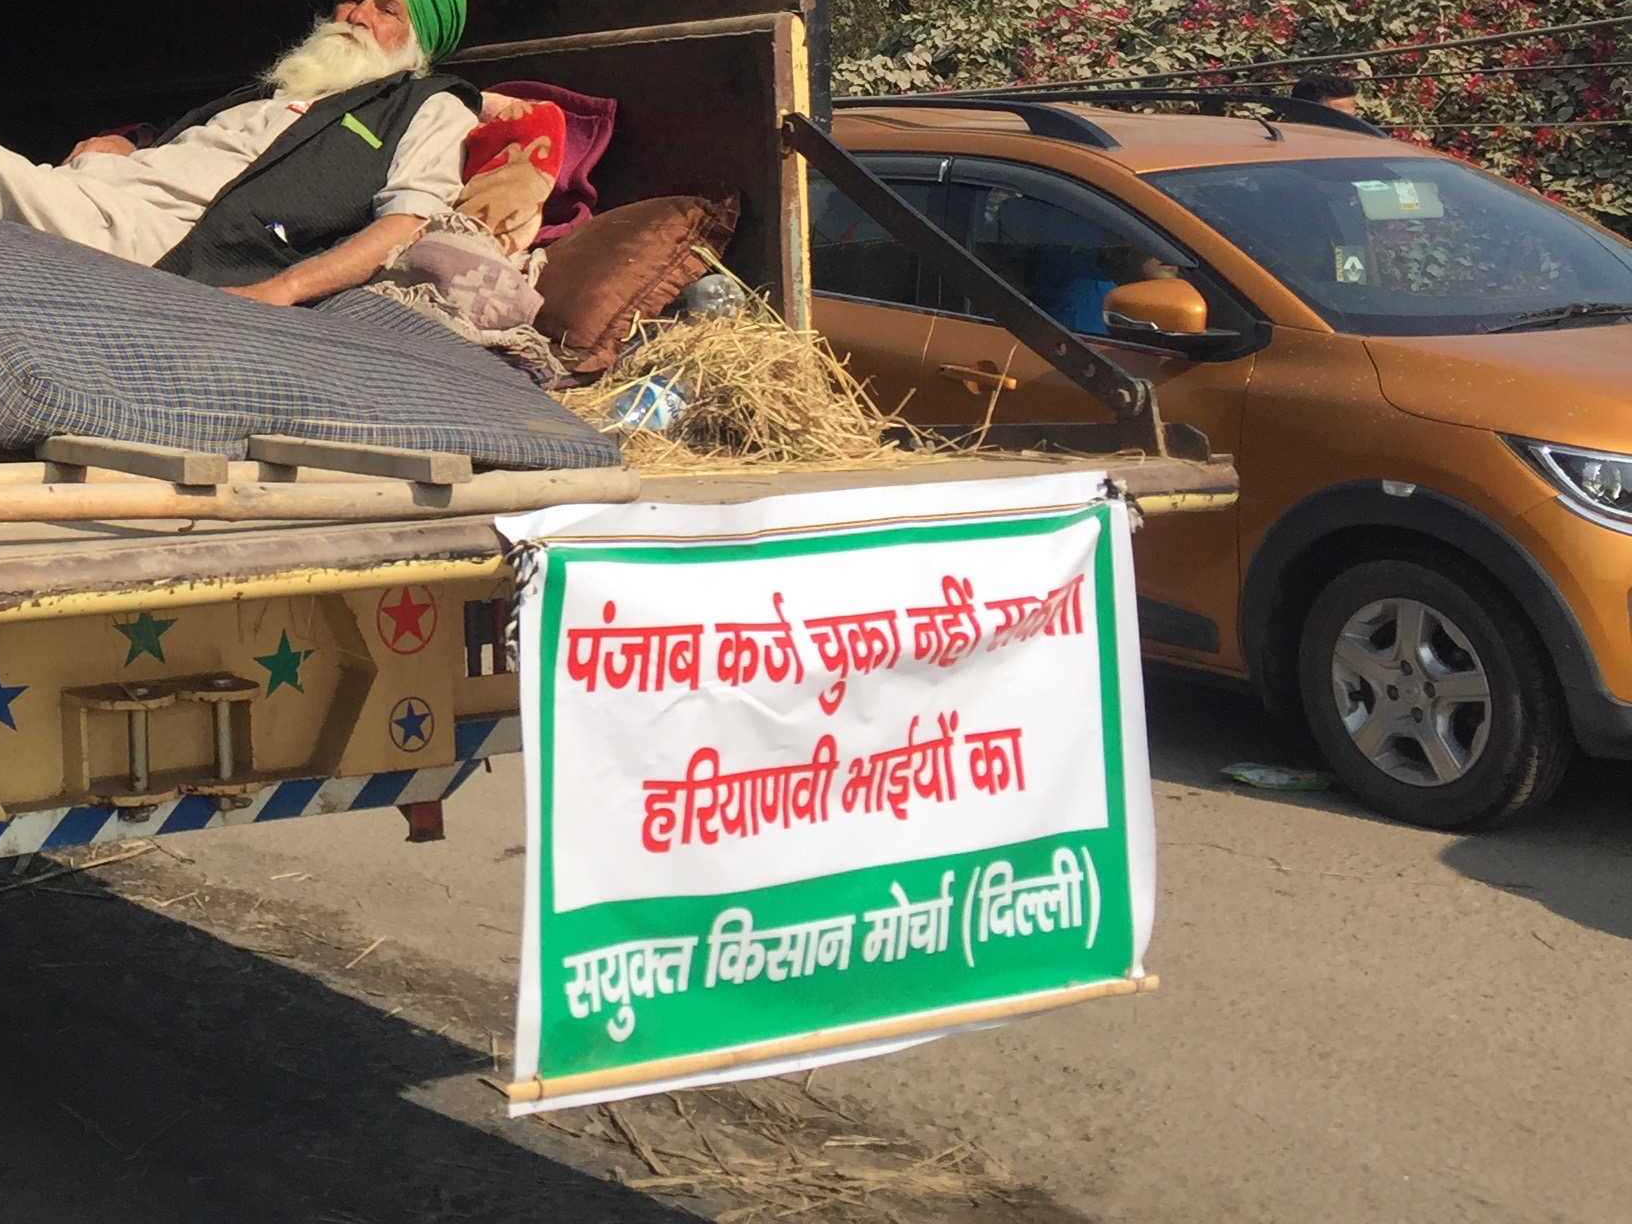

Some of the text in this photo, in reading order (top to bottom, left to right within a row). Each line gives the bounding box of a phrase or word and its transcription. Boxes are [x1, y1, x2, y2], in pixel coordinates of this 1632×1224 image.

[567, 600, 704, 693] पंजाब
[714, 592, 805, 685] कर्ज
[803, 610, 902, 716] चुका
[906, 575, 983, 668] नहीं
[642, 710, 1027, 853] हरियाणवी भाईयों का
[563, 846, 1102, 1042] सयुक्त किसान मोर्चा (दिल्ली)
